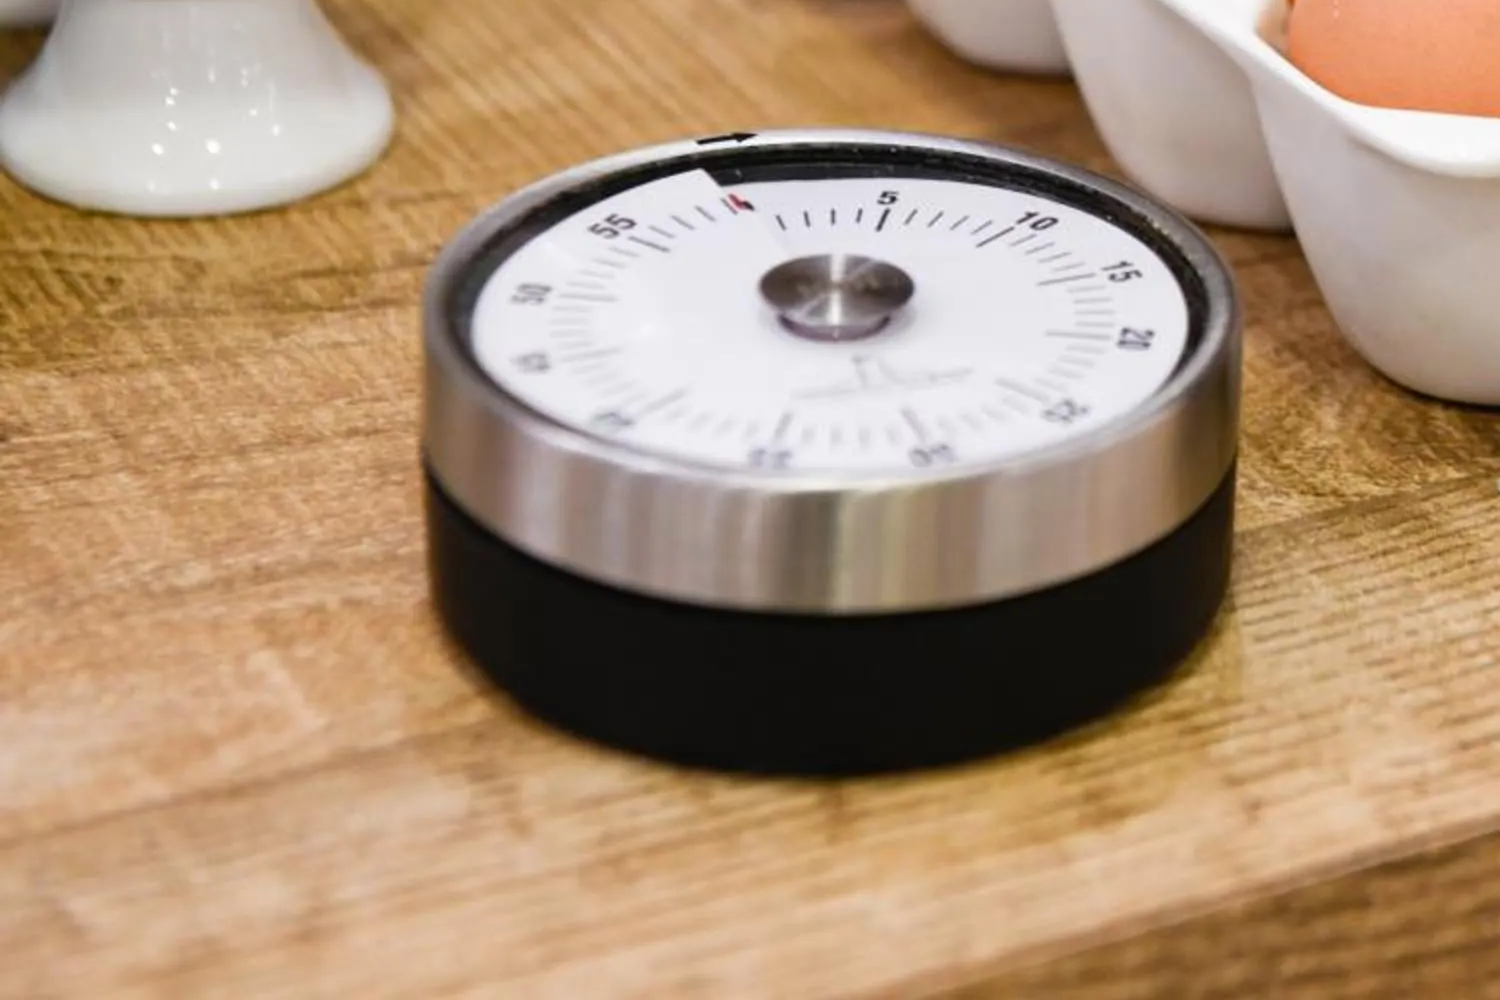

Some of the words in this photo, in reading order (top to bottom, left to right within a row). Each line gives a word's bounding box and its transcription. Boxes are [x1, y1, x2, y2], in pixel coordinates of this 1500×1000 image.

[877, 190, 899, 205] 5
[587, 213, 637, 239] 55
[1016, 211, 1059, 231] 10
[1101, 260, 1143, 283] 15
